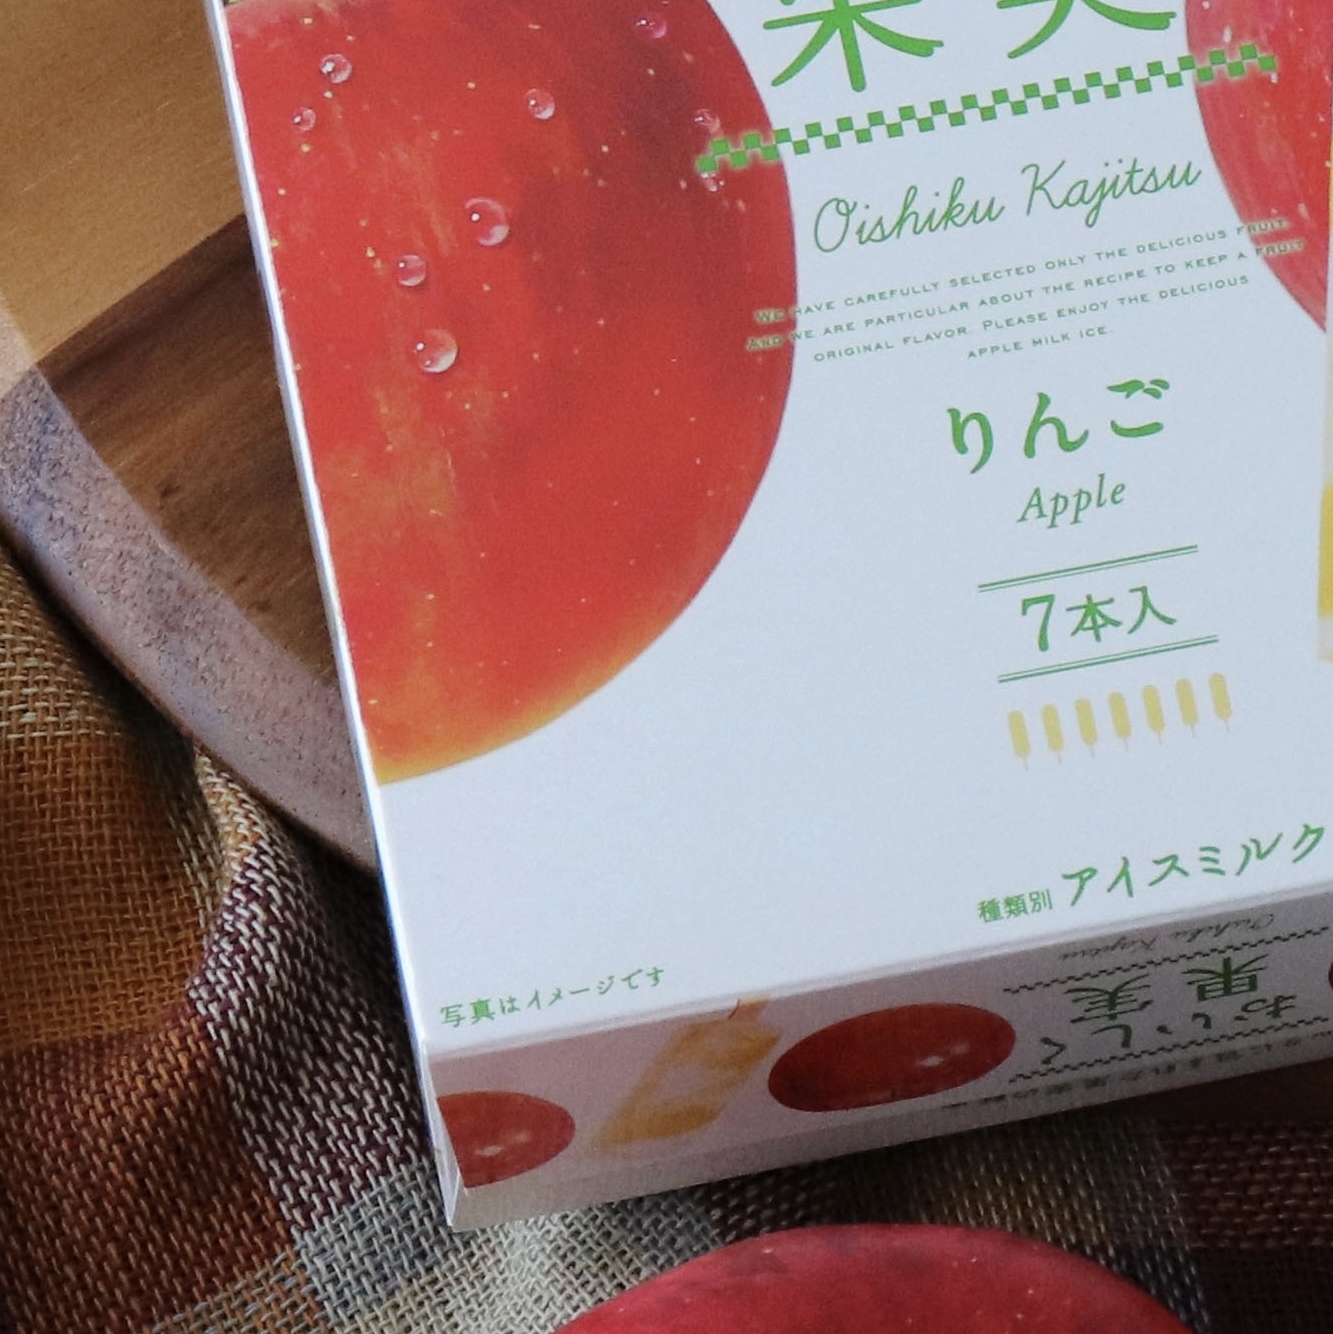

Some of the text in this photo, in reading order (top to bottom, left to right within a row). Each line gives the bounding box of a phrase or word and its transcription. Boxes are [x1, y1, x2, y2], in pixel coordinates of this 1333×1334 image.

[814, 158, 1202, 253] Oishiku Kajitsu
[792, 301, 835, 317] HAVE
[844, 282, 939, 307] CAREFULLY
[949, 265, 1036, 287] SELECTED
[1045, 254, 1087, 270] ONLY
[1095, 247, 1128, 261] THE
[1136, 229, 1227, 254] DELICIOUS
[823, 322, 855, 336] ARE
[865, 301, 969, 327] PARTICULAR
[978, 290, 1034, 307] ABOUT
[1041, 282, 1075, 296] THE
[1084, 269, 1146, 289] RECIPE
[1155, 264, 1176, 276] TO
[1185, 254, 1228, 270] KEEP
[814, 340, 894, 362] ORIGINAL
[1057, 300, 1109, 319] ENJOY
[1117, 292, 1150, 307] THE
[1158, 275, 1249, 300] DELICIOUS
[967, 341, 1023, 360] APPLE
[1031, 333, 1071, 347] MILK
[946, 378, 1170, 475] りんご
[1016, 472, 1126, 529] Apple
[1020, 585, 1177, 652] 7本入
[977, 823, 1326, 924] 種類別 アイスミルク
[439, 966, 665, 1028] 写真はイメージです
[1063, 953, 1270, 1024] 果実
[1040, 993, 1298, 1065] おいしく
